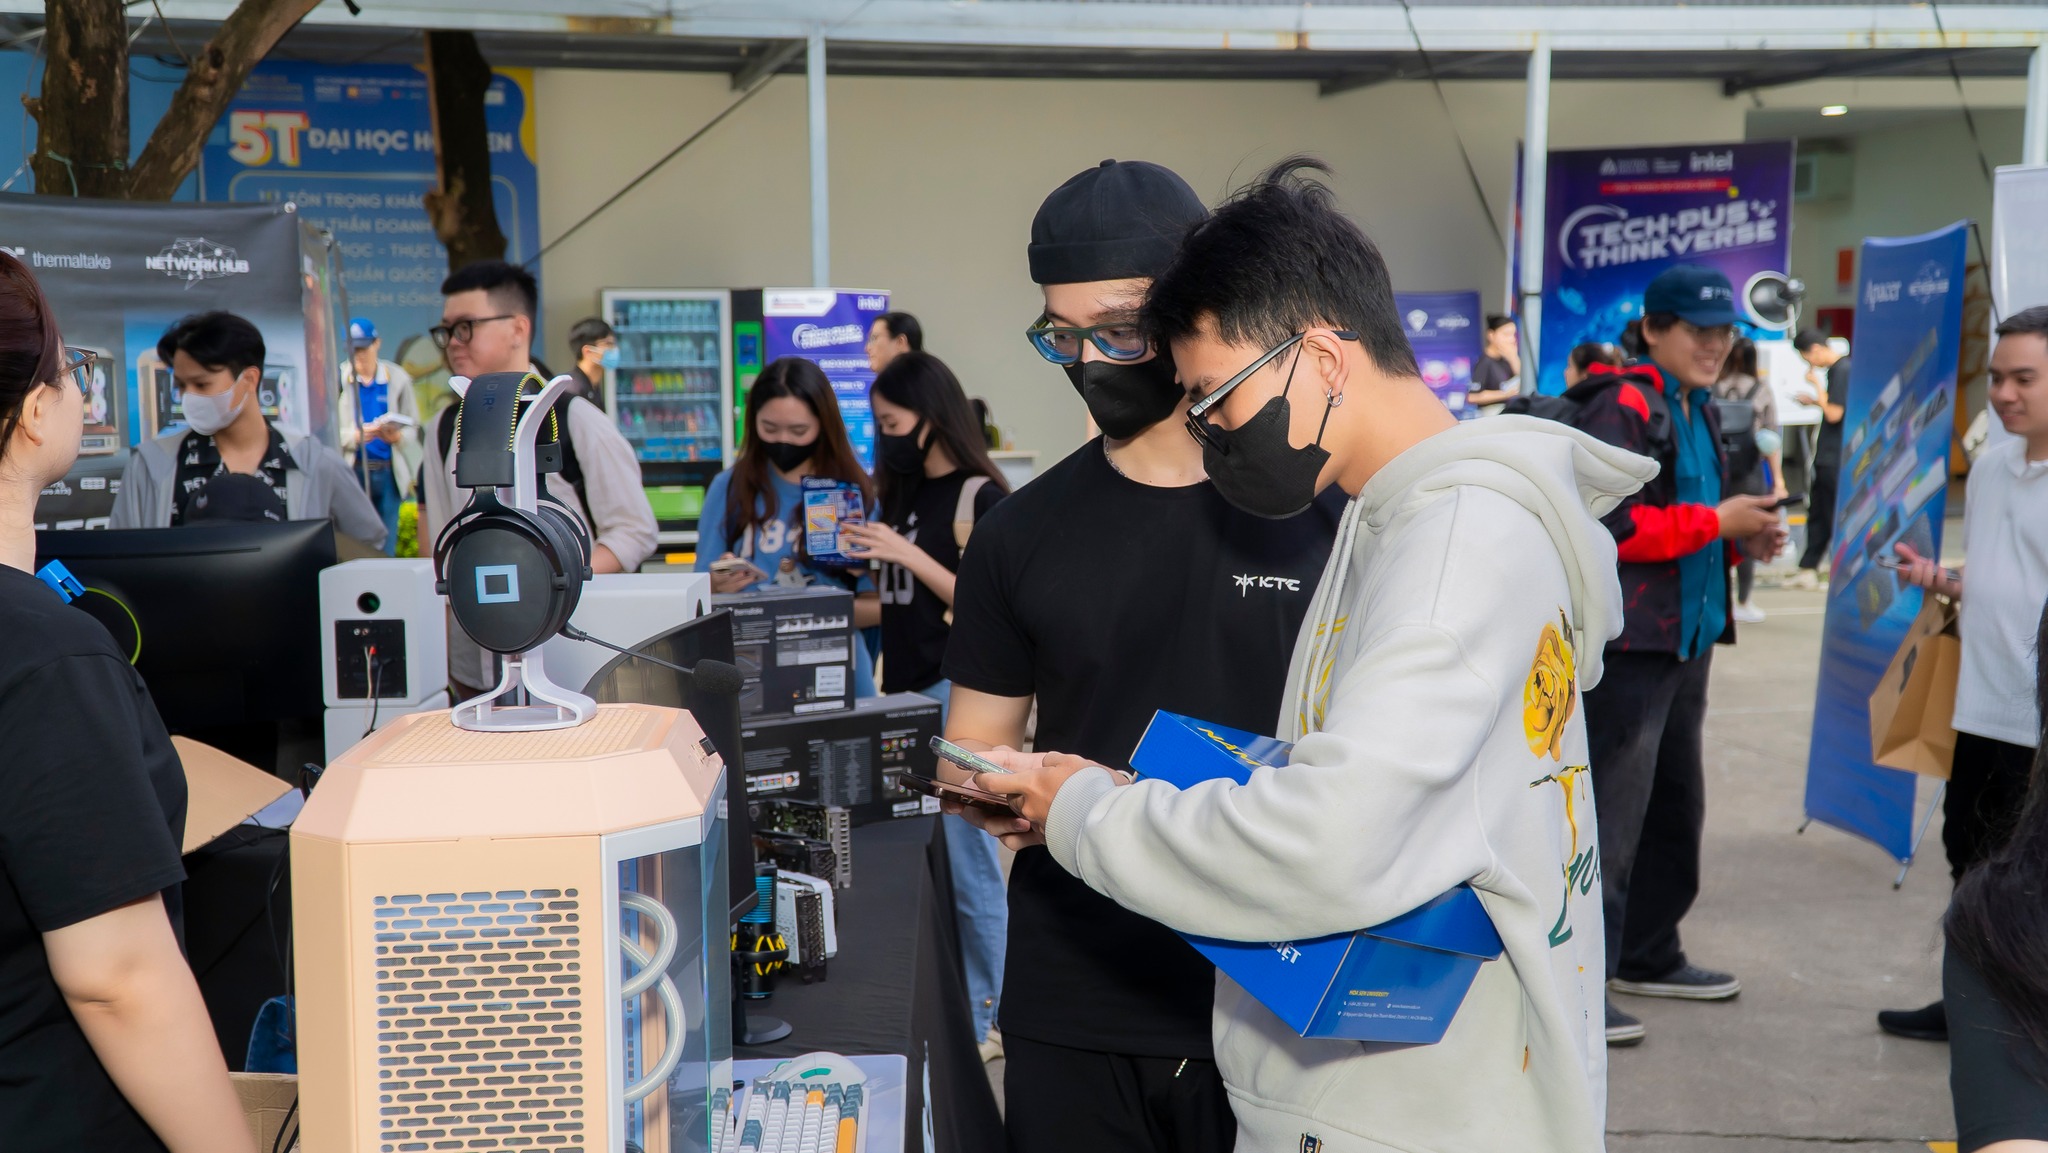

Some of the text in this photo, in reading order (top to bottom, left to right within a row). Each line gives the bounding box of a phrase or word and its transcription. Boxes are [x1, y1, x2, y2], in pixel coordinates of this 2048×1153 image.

[229, 109, 309, 167] 5T
[308, 128, 350, 155] ĐẠI
[355, 129, 409, 156] HỌC
[1689, 151, 1734, 173] intel
[325, 192, 382, 212] TRỌNG
[32, 250, 112, 270] thermaltake
[145, 255, 250, 274] NETWORK HUB
